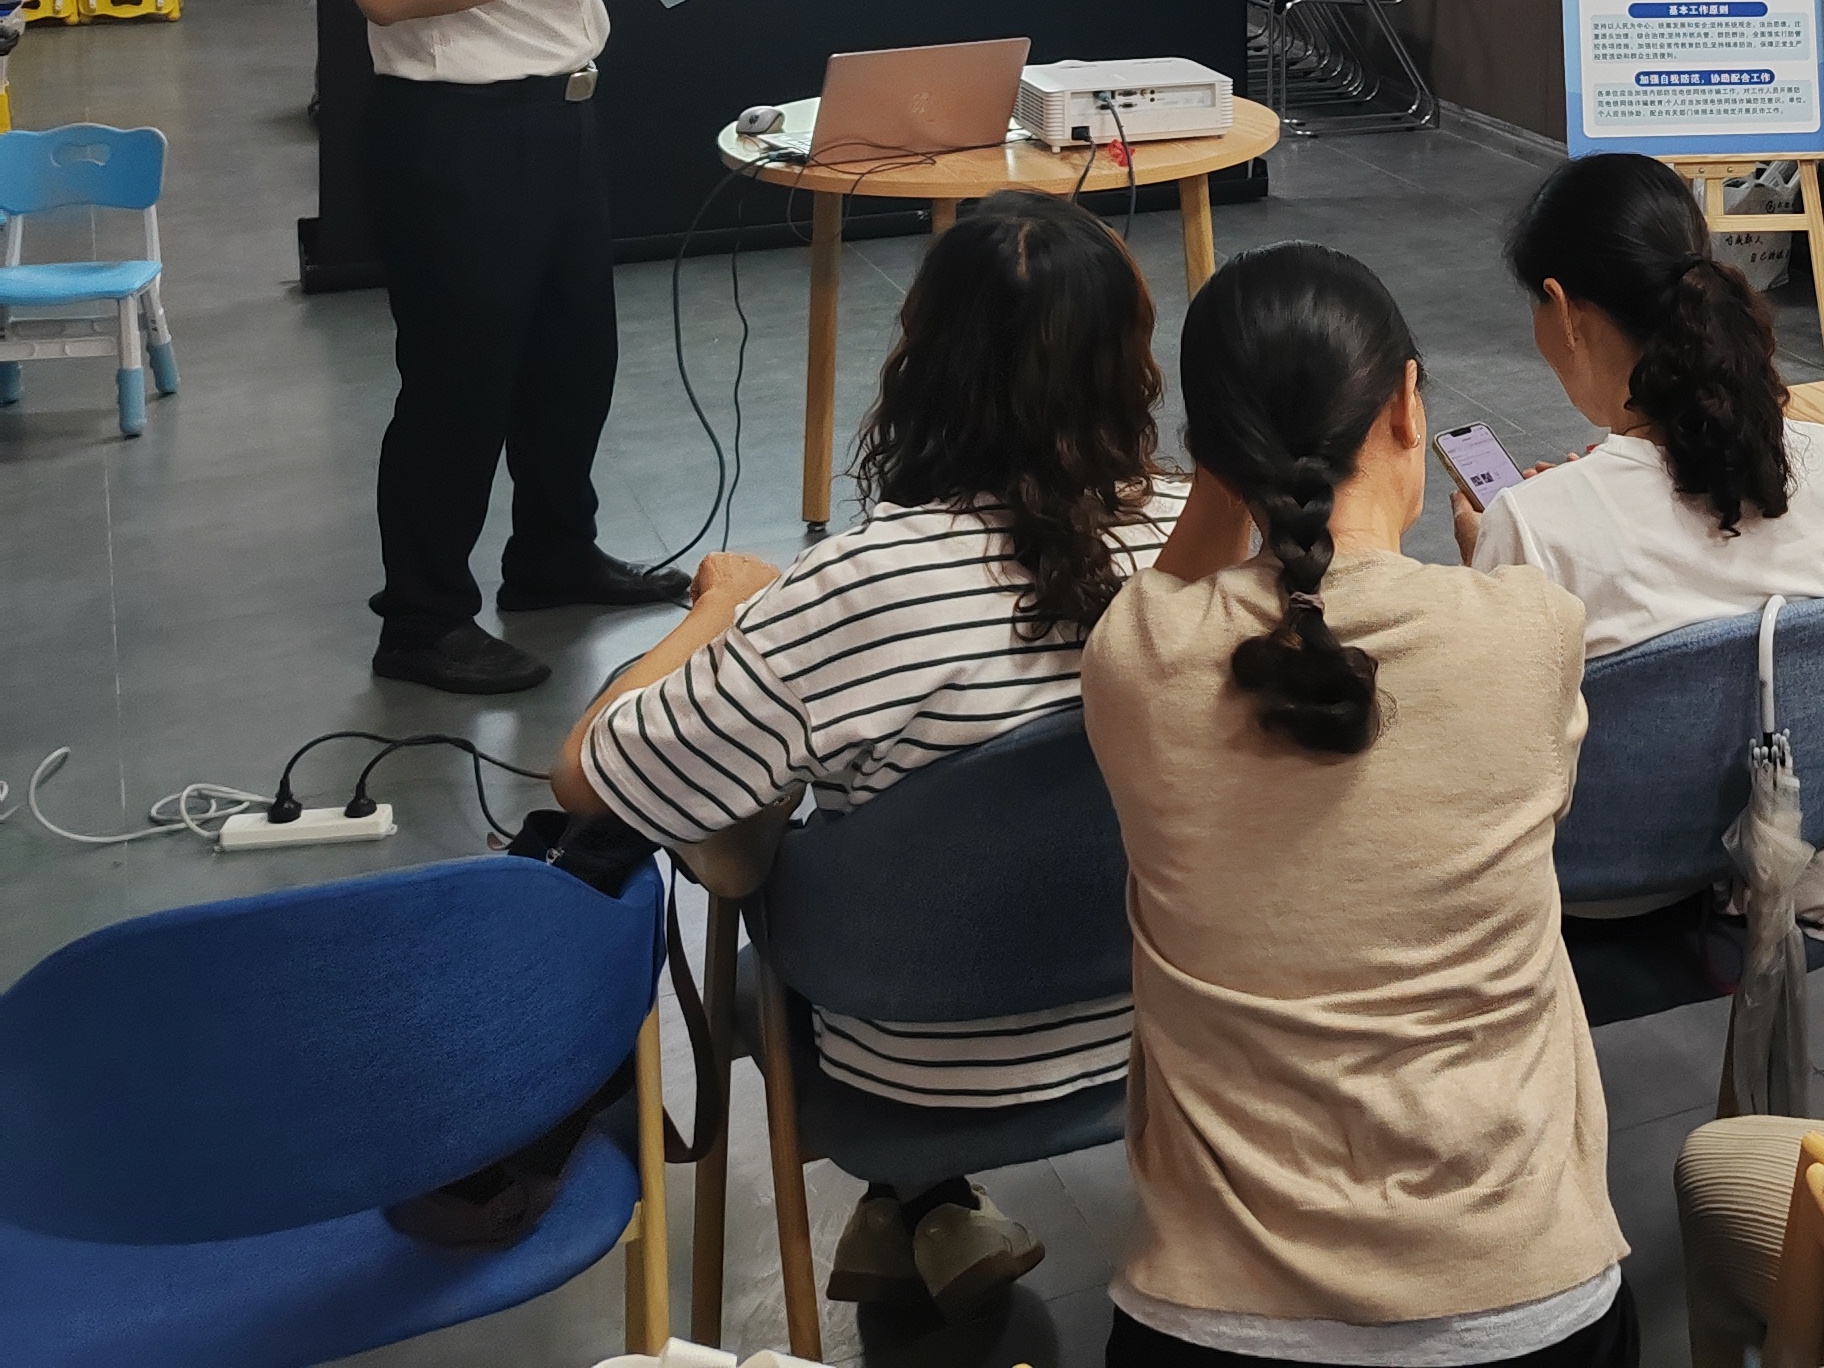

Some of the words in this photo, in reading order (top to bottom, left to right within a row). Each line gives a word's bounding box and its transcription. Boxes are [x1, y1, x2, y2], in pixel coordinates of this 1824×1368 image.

[1669, 4, 1729, 15] 基本工作原则
[1639, 73, 1771, 85] 加强自我防范，协助配合工作
